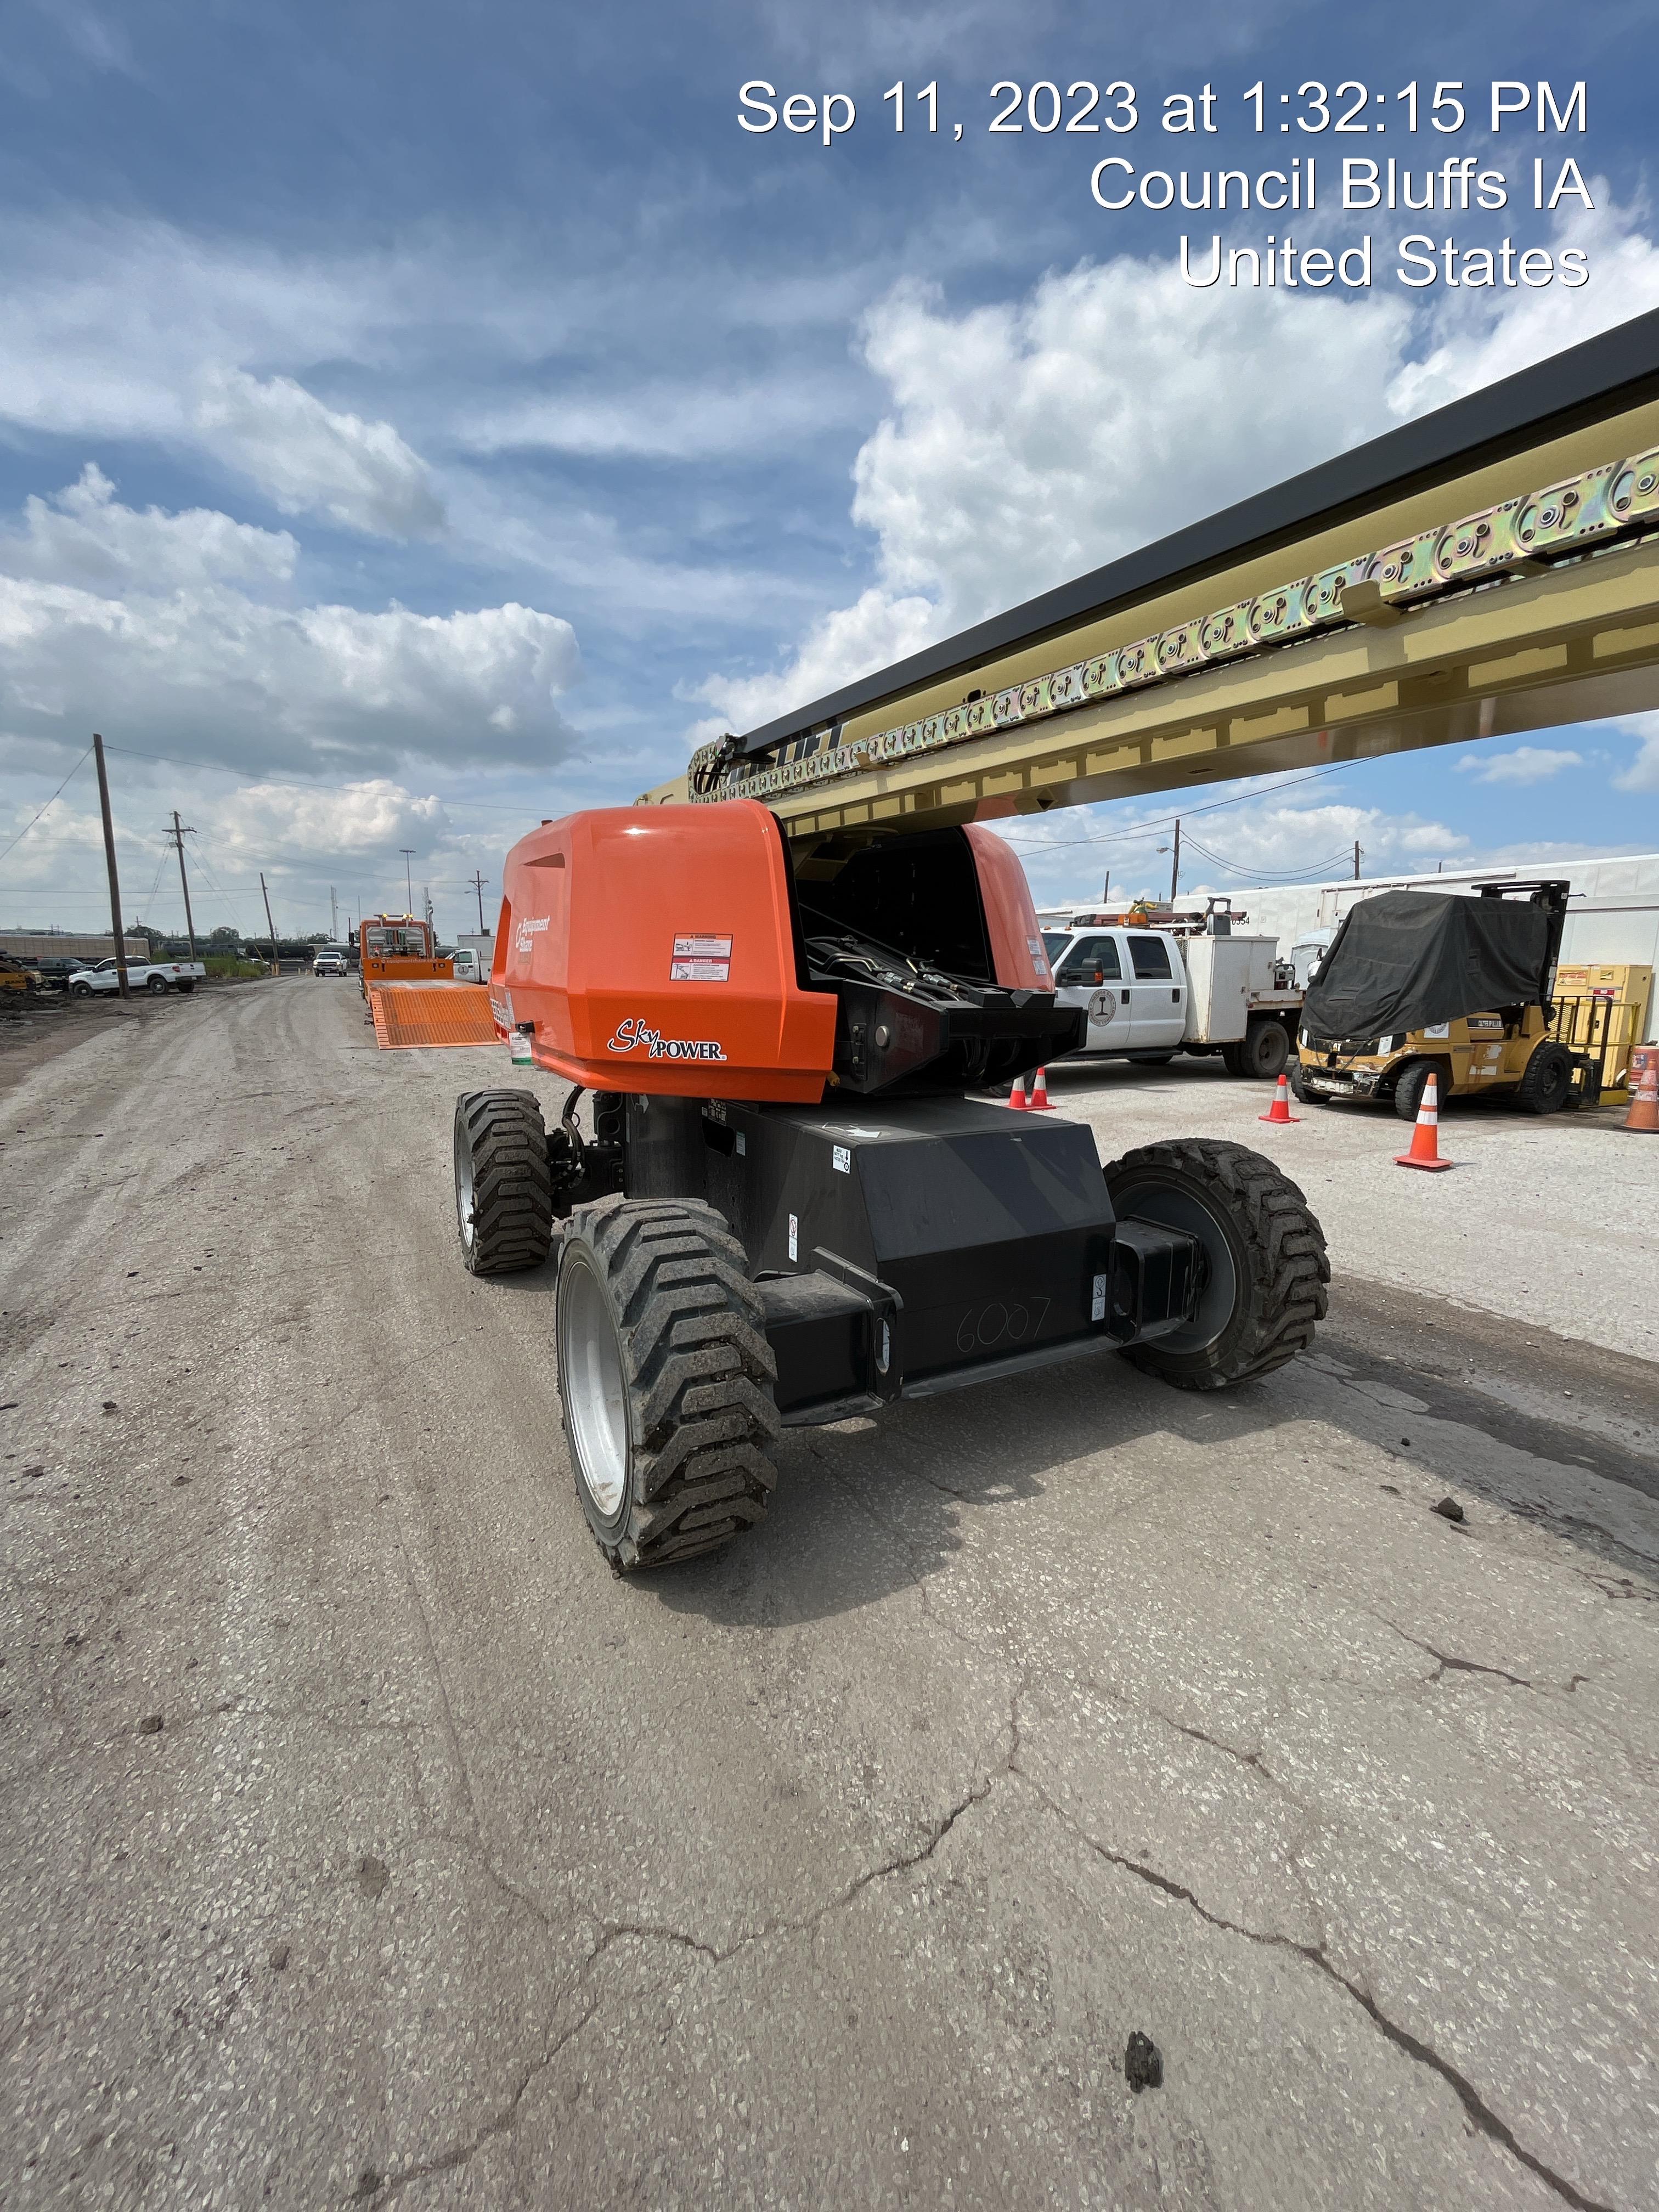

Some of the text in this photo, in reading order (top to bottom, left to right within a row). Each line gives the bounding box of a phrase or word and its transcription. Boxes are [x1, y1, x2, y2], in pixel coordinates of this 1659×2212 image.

[522, 915, 550, 936] Equipment
[519, 937, 533, 952] Share
[607, 1019, 721, 1060] Sky POWER
[956, 1296, 1051, 1352] 6007
